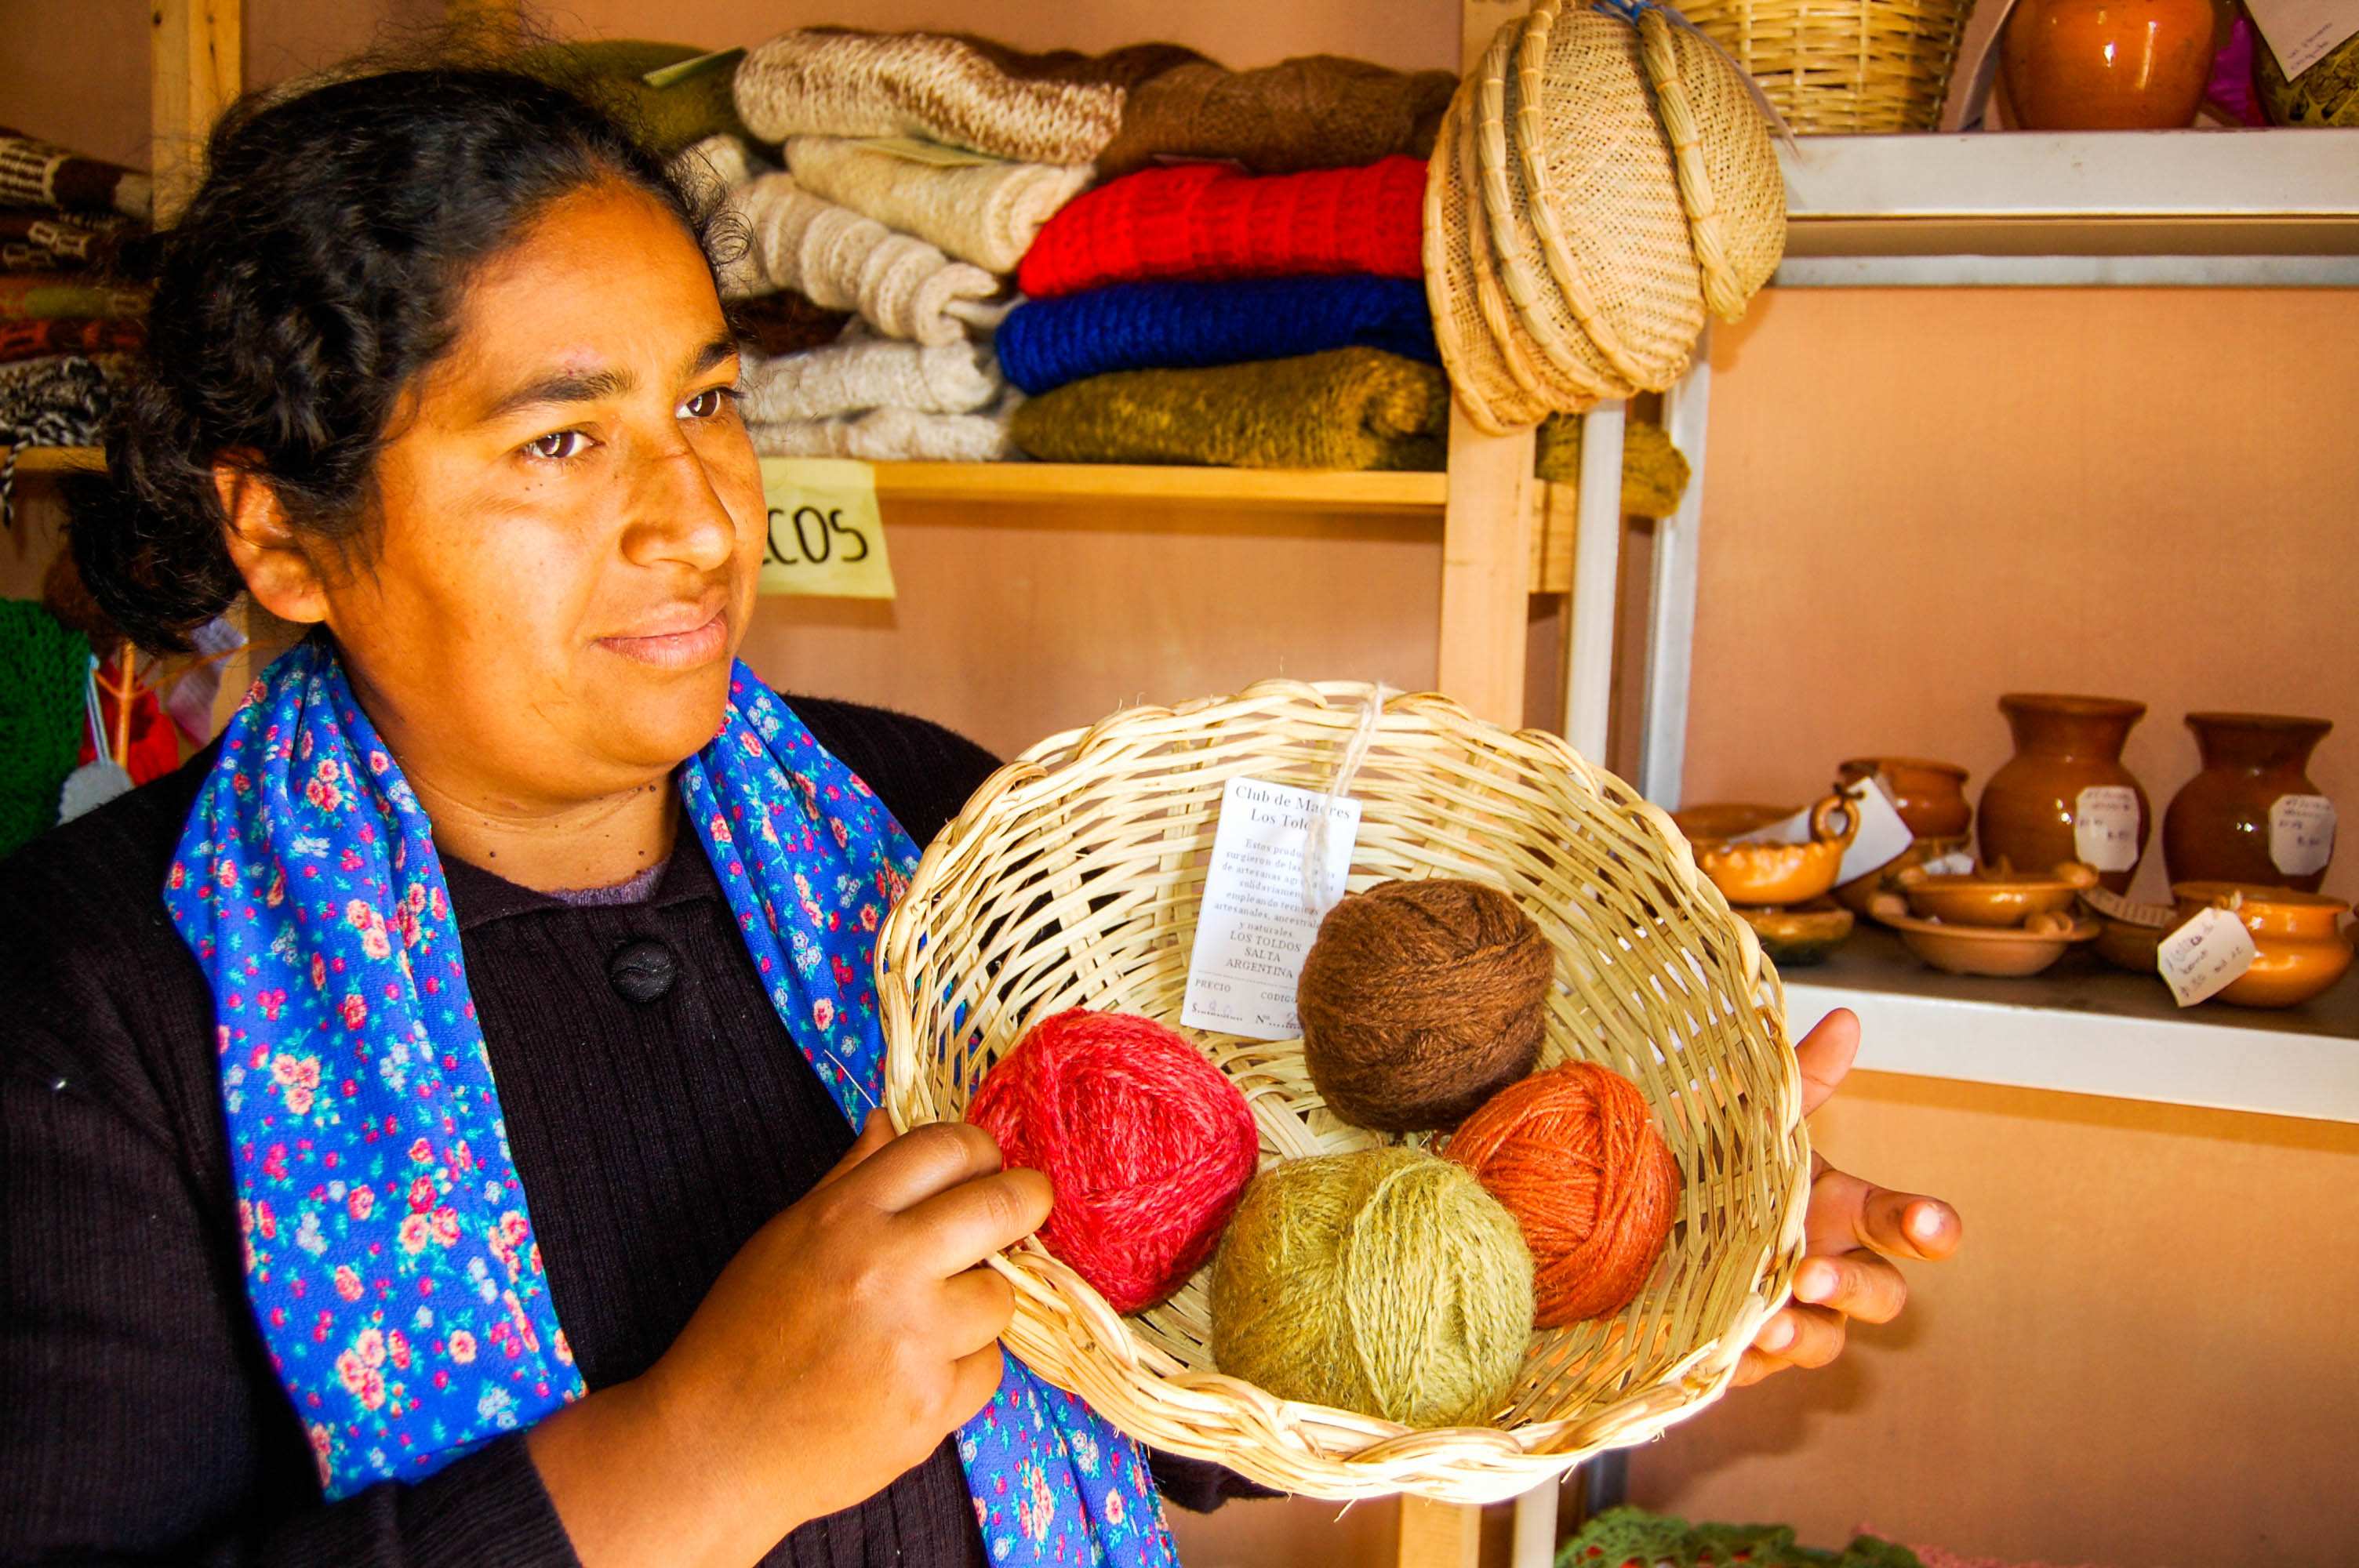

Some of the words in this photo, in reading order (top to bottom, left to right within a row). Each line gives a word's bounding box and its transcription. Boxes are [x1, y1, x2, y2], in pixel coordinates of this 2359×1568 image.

[763, 506, 868, 565] COS
[1235, 785, 1270, 803] Club
[1274, 793, 1291, 808] de
[1251, 808, 1276, 824] Los
[1245, 838, 1271, 852] Estos
[1226, 851, 1272, 866] surgieron
[1274, 859, 1286, 869] de
[1222, 862, 1233, 872] de
[1236, 868, 1281, 882] artesanas
[1239, 879, 1303, 899] solidariamen
[1226, 891, 1279, 908] empleando
[1247, 923, 1293, 938] naturales
[1230, 931, 1253, 943] LOS
[1256, 935, 1303, 953] TOLDOS
[1244, 946, 1281, 963] SALTA
[1225, 958, 1293, 979] ARGENTINA
[1194, 978, 1231, 993] PRECIO
